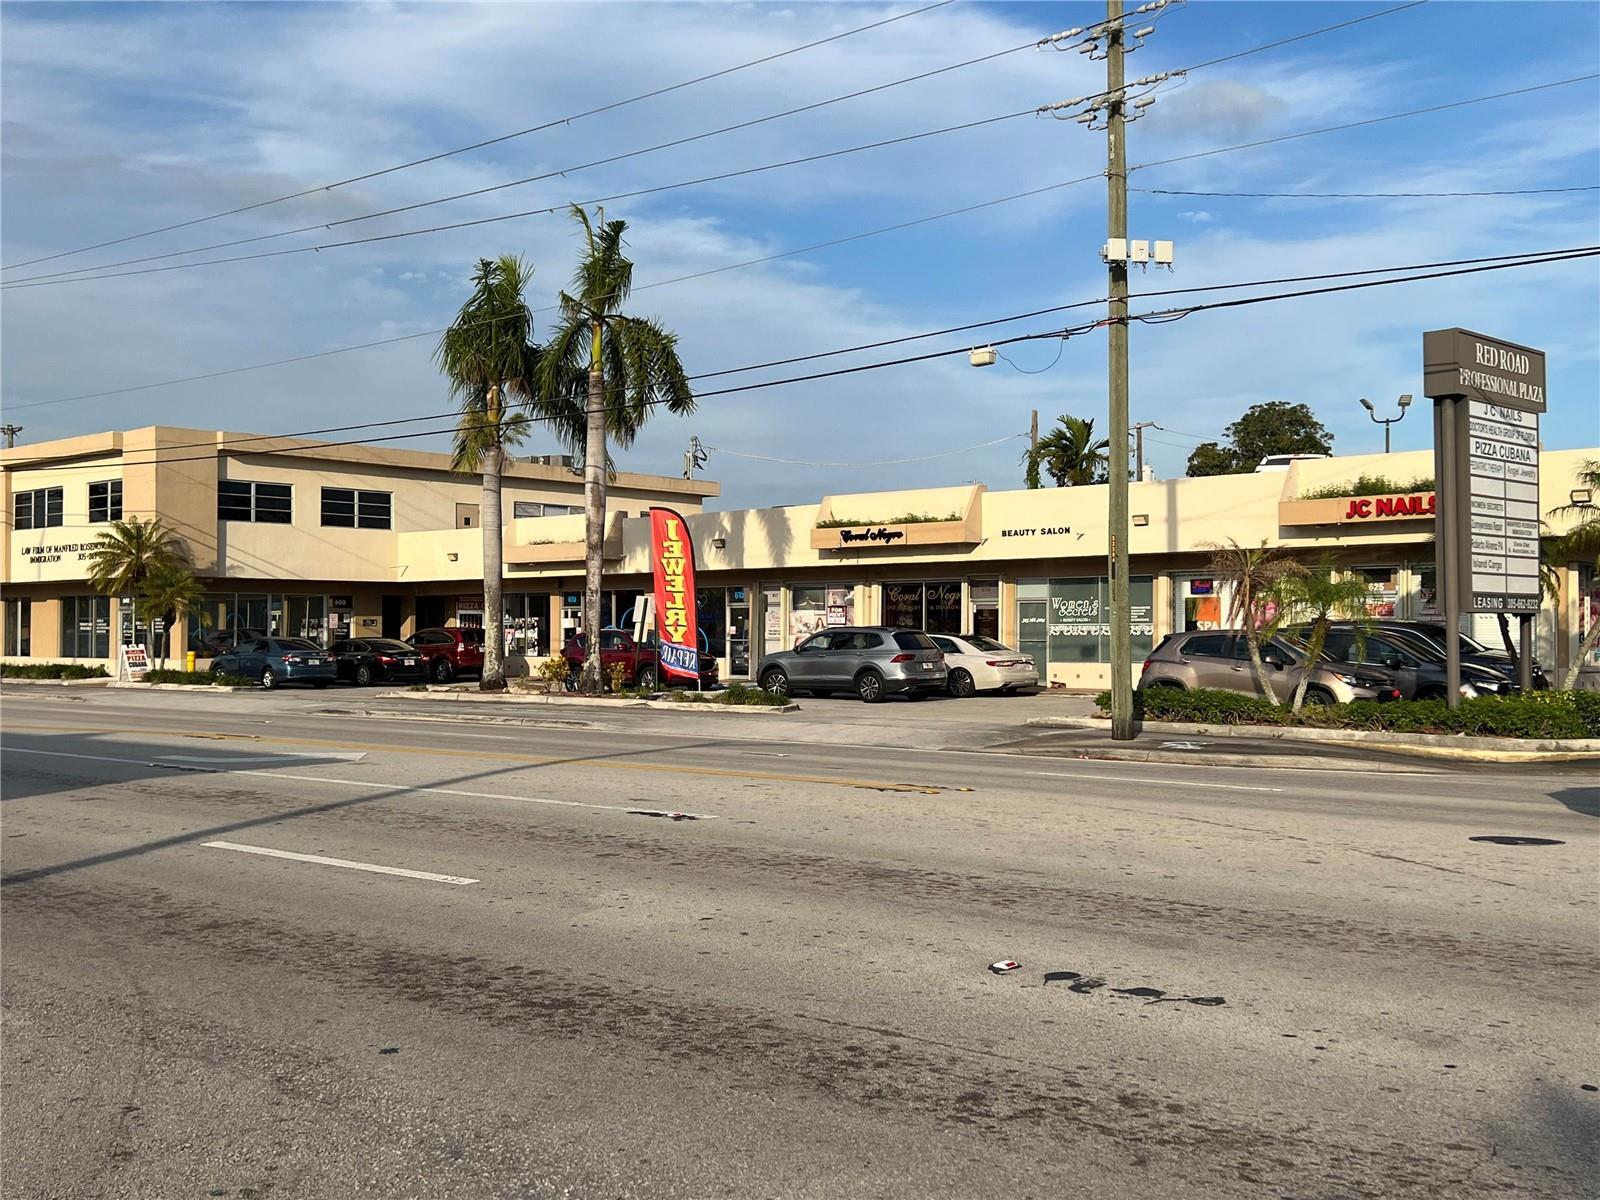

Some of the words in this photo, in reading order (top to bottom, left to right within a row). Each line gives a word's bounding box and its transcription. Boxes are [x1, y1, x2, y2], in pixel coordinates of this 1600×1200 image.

[1475, 343, 1498, 367] RED
[1500, 350, 1529, 375] ROAD
[1459, 368, 1518, 397] PROFESSIONAL
[1519, 382, 1544, 403] PLAZA
[1500, 409, 1522, 422] NAILS
[1475, 441, 1497, 457] PIZZA
[1499, 445, 1531, 463] CUBANA
[1346, 499, 1372, 519] JC
[1376, 495, 1435, 517] NAILS
[840, 528, 870, 543] Coral
[870, 528, 903, 544] Negro
[1002, 528, 1037, 537] BEAUTY
[1040, 527, 1071, 536] SALON
[46, 545, 53, 553] OF
[54, 543, 79, 552] MANFRED
[887, 585, 922, 602] Coral
[1368, 582, 1384, 591] 625
[1052, 596, 1099, 610] Women's
[1473, 597, 1504, 609] LEASING
[1196, 620, 1220, 631] SPA
